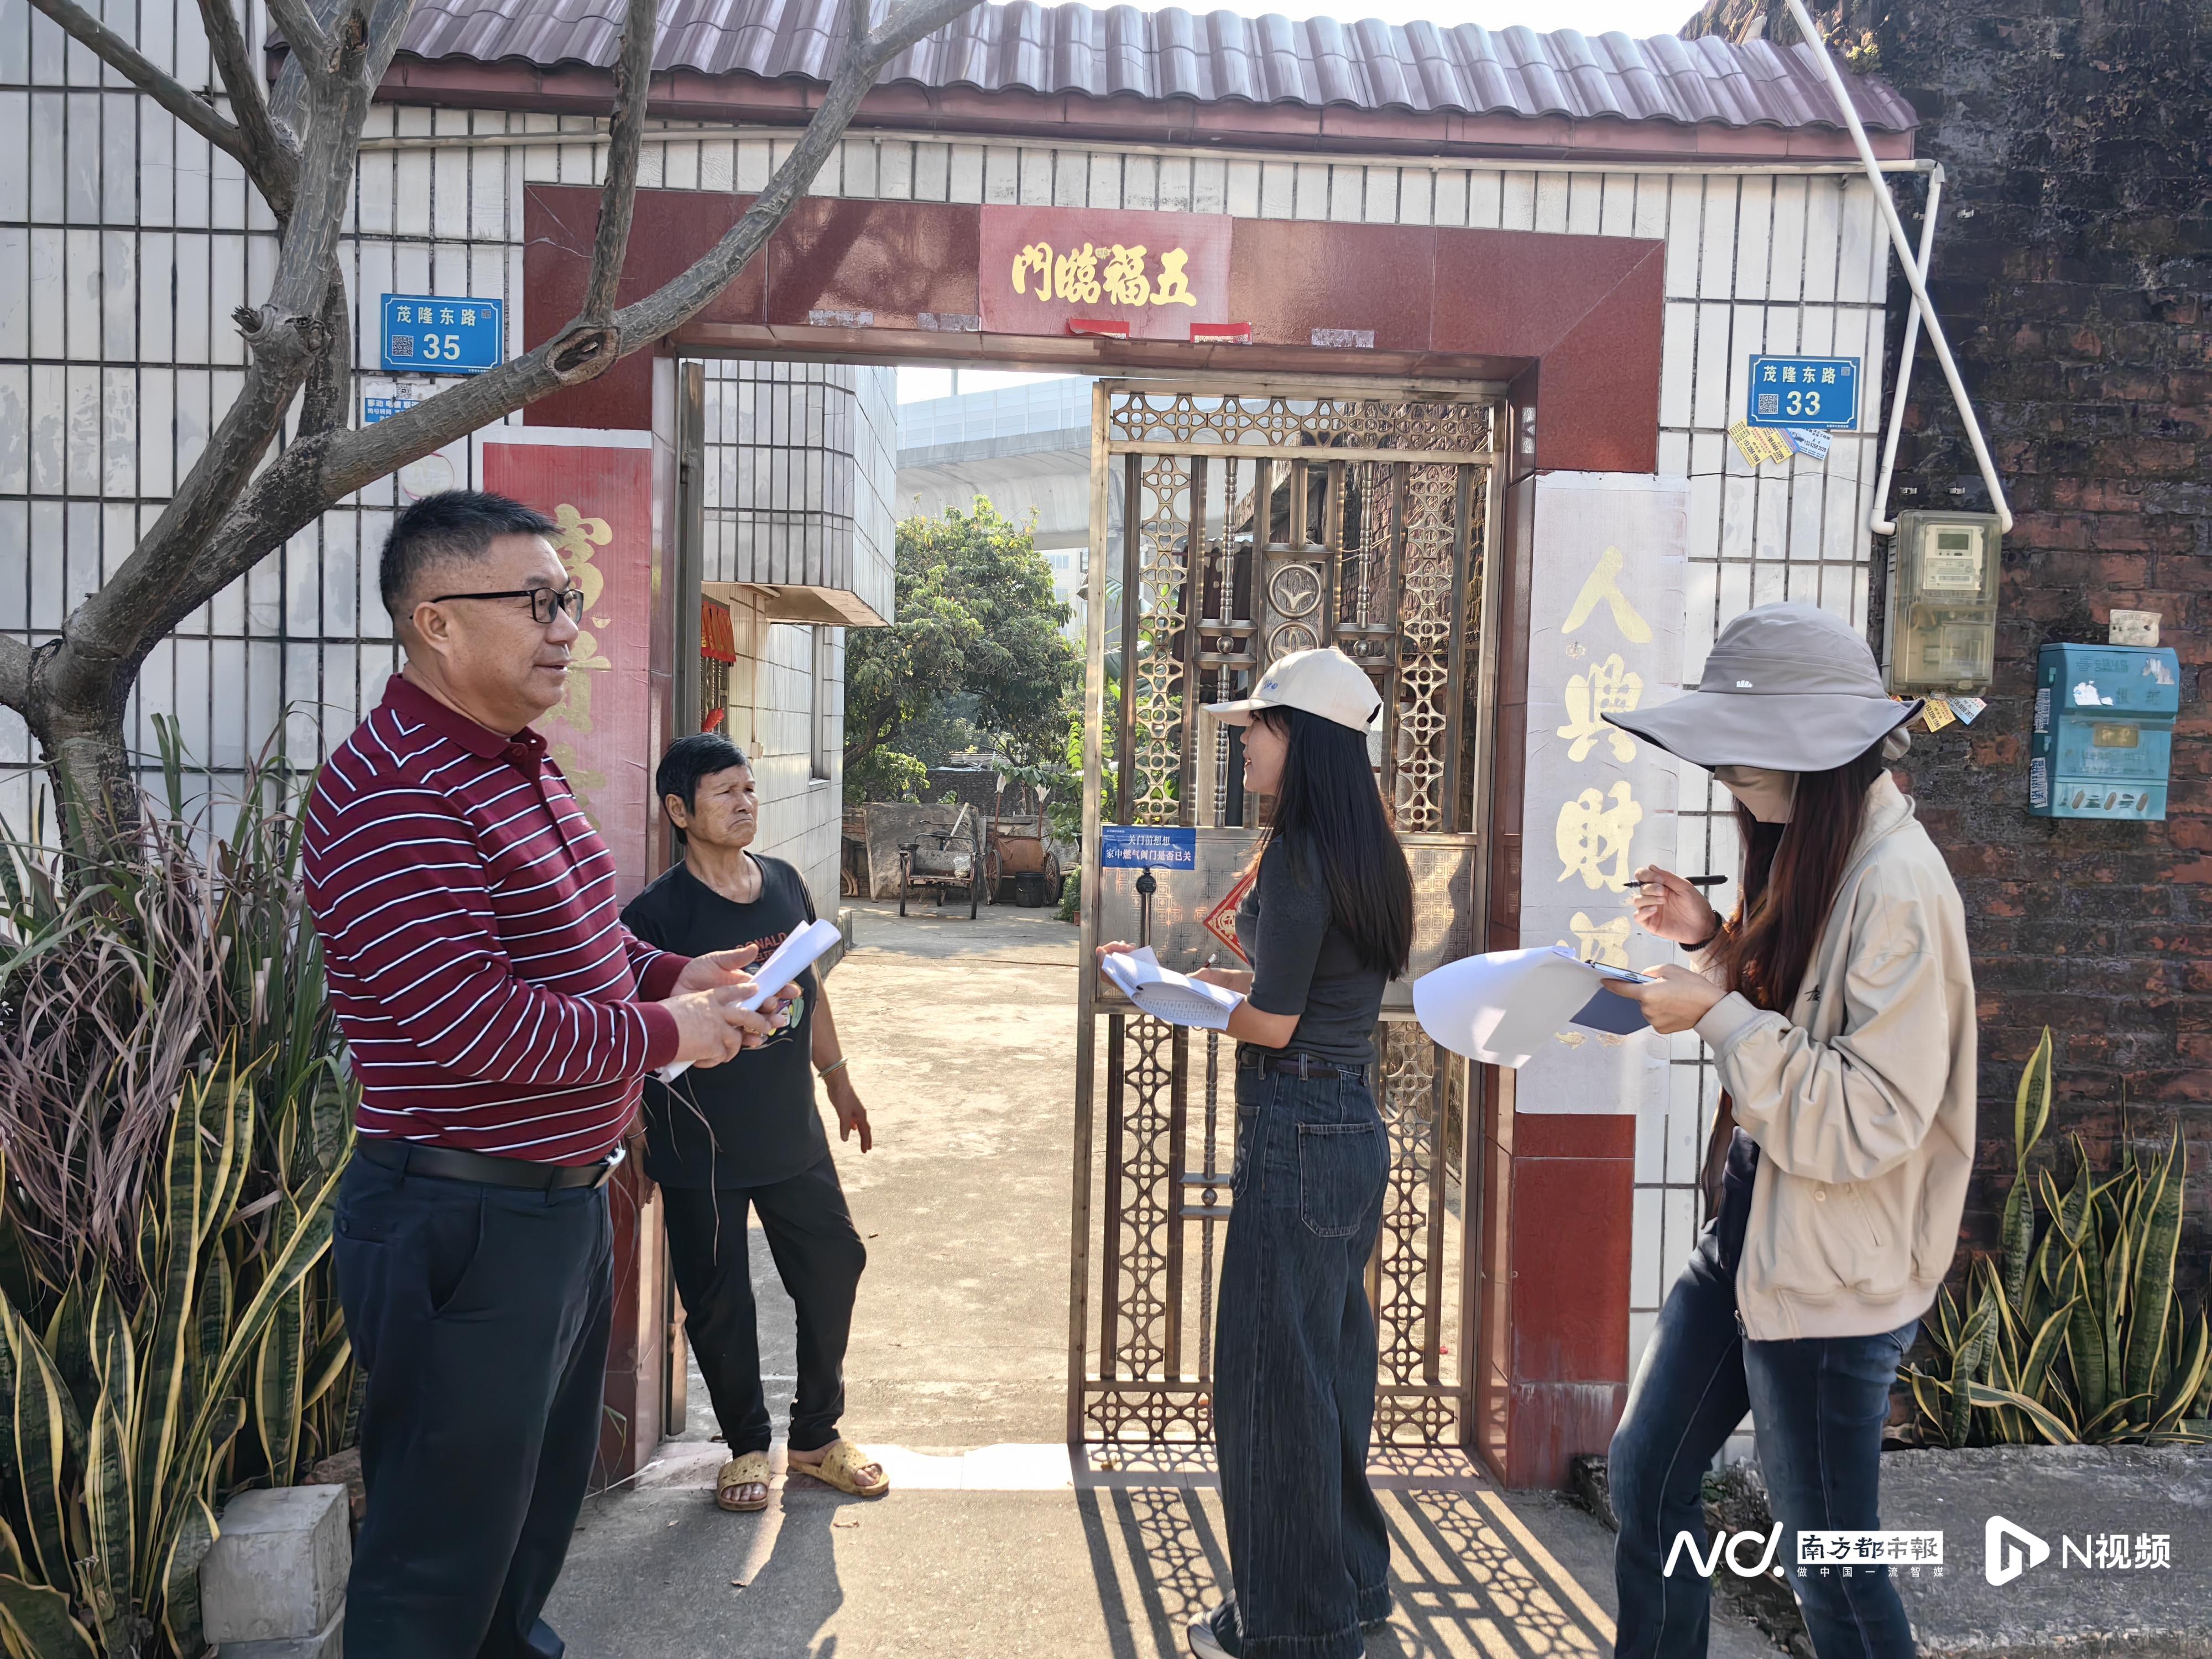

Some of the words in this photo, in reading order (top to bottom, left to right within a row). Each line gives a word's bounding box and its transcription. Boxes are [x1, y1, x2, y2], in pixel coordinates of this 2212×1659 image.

[397, 305, 476, 326] 茂隆东路
[423, 333, 460, 359] 35
[1763, 365, 1836, 384] 茂隆东路
[1786, 390, 1820, 415] 33
[1128, 834, 1170, 846] 关门前想想
[1106, 848, 1191, 862] 家中燃气阀门是否已关
[735, 932, 787, 950] NALD
